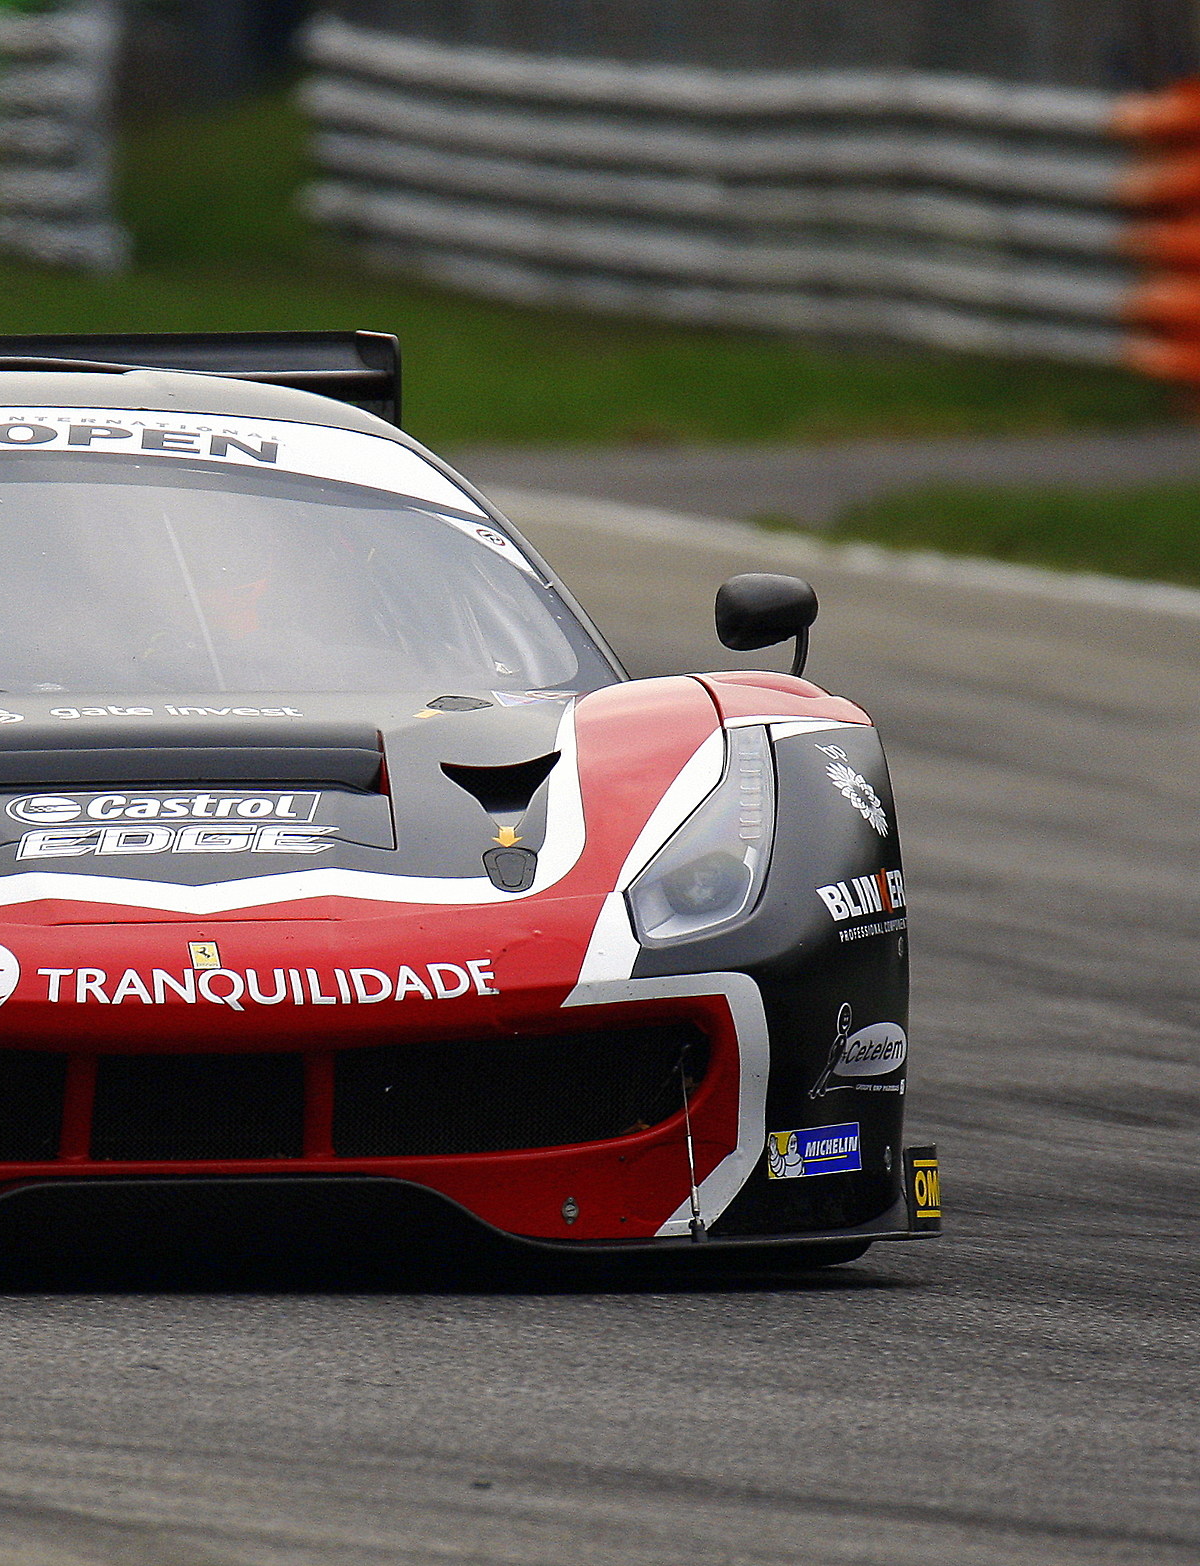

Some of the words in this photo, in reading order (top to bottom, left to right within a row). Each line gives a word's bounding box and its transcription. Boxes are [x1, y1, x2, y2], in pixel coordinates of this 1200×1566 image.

[48, 704, 158, 720] gate
[165, 703, 304, 718] invest
[86, 793, 298, 822] Castrol
[16, 824, 340, 861] EDGE
[37, 958, 500, 1012] TRANQUILIDADE
[845, 1035, 904, 1065] Cetelem
[804, 1135, 859, 1159] MICHELIN
